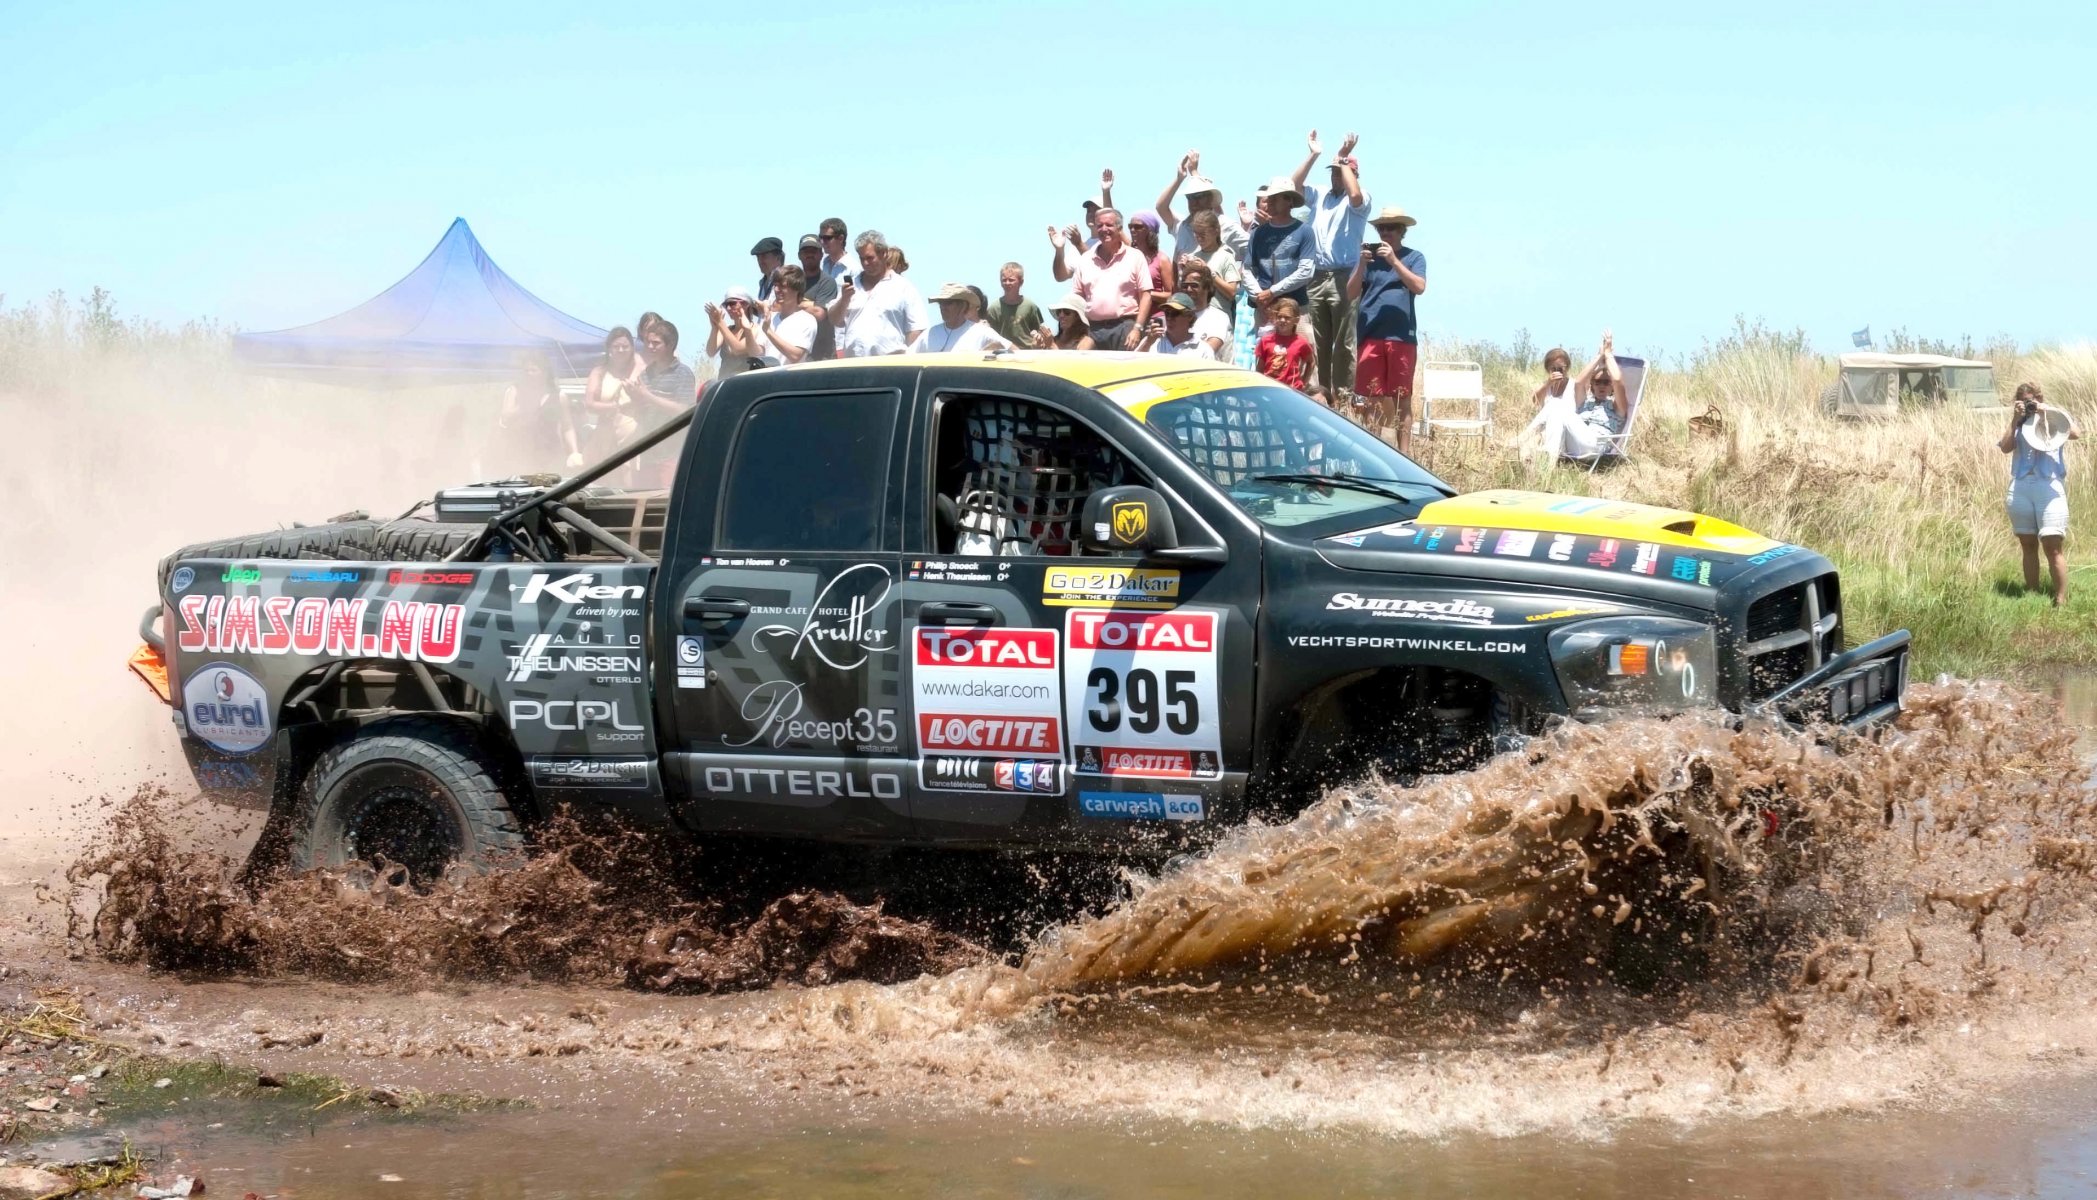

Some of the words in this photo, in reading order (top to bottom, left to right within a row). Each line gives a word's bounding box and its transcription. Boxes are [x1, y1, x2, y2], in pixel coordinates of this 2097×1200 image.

[221, 564, 261, 585] Jeep
[925, 560, 947, 571] Philip
[306, 571, 358, 582] SUBARU
[404, 573, 474, 584] DODGE
[923, 571, 944, 581] Henk
[519, 573, 645, 604] Kien
[1105, 594, 1159, 602] EXPERIENCE
[1326, 592, 1494, 618] Sumedia
[575, 606, 604, 616] driven
[607, 606, 618, 618] by
[620, 608, 640, 617] you.
[751, 606, 782, 615] GRAND
[818, 608, 849, 616] HOTEL
[178, 595, 466, 663] SIMSON.NU
[1075, 615, 1209, 648] TOTAL
[921, 632, 1051, 665] TOTAL
[1288, 635, 1526, 654] VECHTSPORTWINKEL.COM
[510, 656, 641, 673] THEUNISSEN
[596, 676, 641, 684] OTTERLO
[921, 681, 1050, 699] www.dakar.com
[1087, 667, 1200, 735] 395
[193, 697, 264, 728] eurol
[509, 700, 645, 731] PCPL
[596, 733, 645, 742] support
[927, 718, 1049, 748] LOCTITE
[856, 744, 898, 753] restaurant
[1107, 753, 1186, 771] LOCTITE
[704, 766, 900, 799] OTTERLO
[999, 763, 1012, 785] 2
[1018, 763, 1032, 786] 3
[1037, 764, 1052, 787] 4
[1084, 798, 1161, 815] carwash
